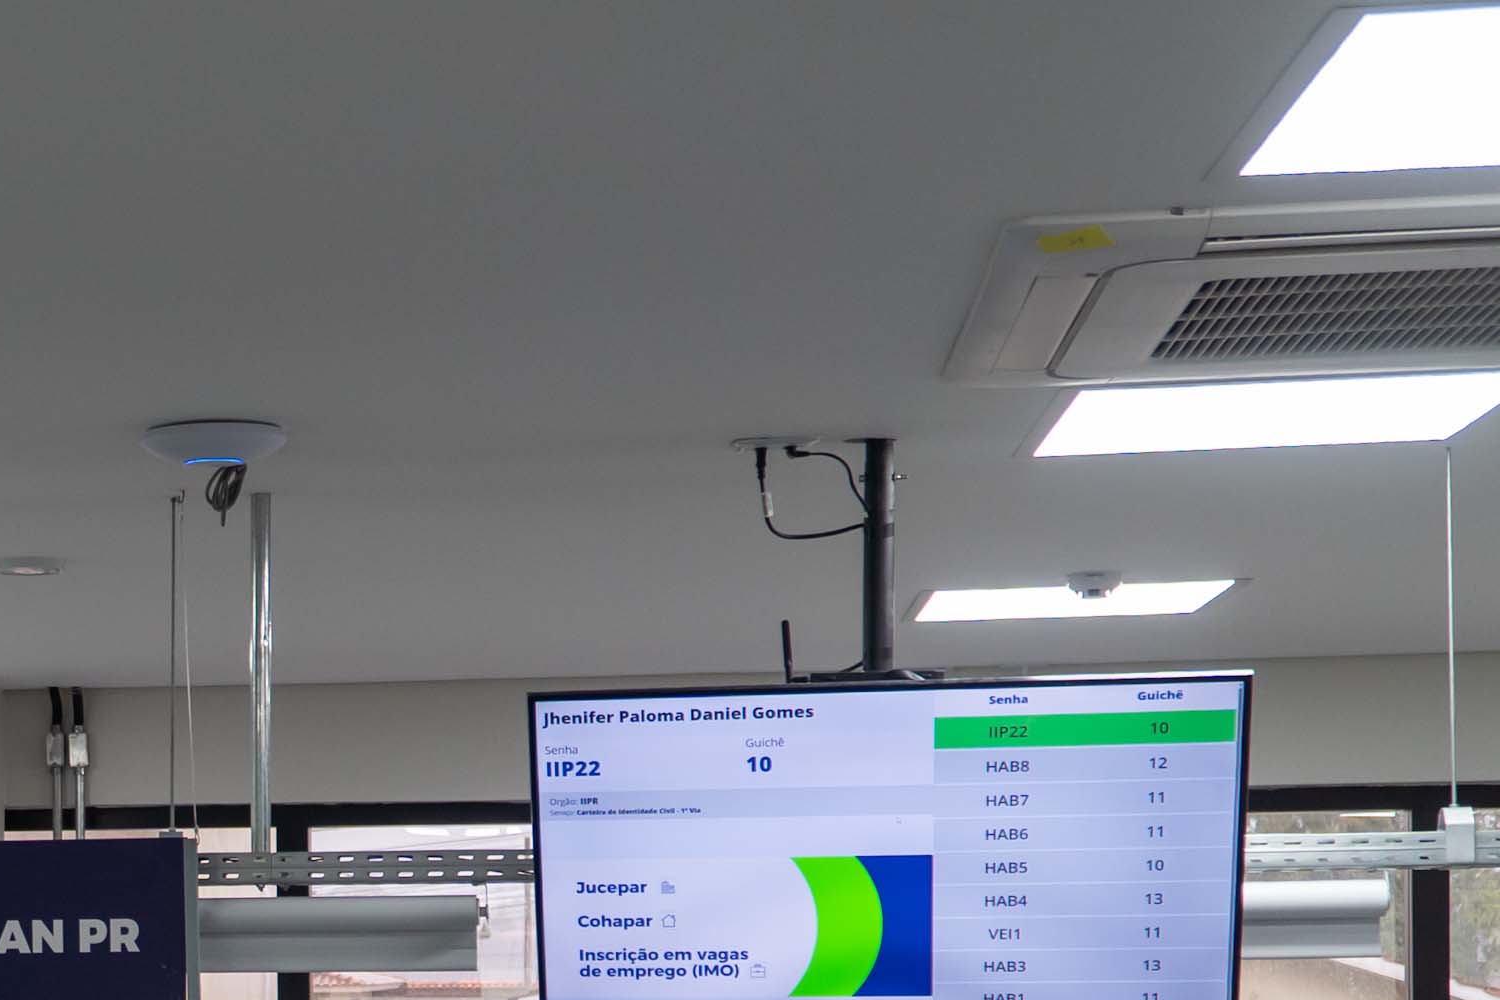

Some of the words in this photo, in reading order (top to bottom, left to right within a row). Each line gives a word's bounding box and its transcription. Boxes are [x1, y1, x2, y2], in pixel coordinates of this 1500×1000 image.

[988, 694, 1028, 704] Senha
[1137, 690, 1184, 700] Guichê
[542, 711, 614, 729] Jhenifer
[620, 709, 685, 722] Paloma
[690, 706, 746, 720] Daniel
[752, 706, 814, 719] Gomes
[989, 726, 1028, 738] IIP22
[1150, 722, 1170, 735] 10
[544, 745, 578, 754] Senha
[746, 738, 785, 748] Guichê
[546, 761, 600, 776] IIP22
[746, 756, 772, 772] 10
[986, 760, 1030, 773] HAB8
[1150, 757, 1168, 769] 12
[986, 794, 1030, 807] HAB7
[1148, 792, 1165, 804] 11
[576, 808, 606, 816] Carteira
[608, 808, 617, 816] de
[986, 828, 1028, 840] HAB6
[1148, 826, 1164, 838] 11
[985, 862, 1028, 874] HAB5
[1146, 860, 1164, 872] 10
[576, 882, 648, 896] Jucepar
[984, 895, 1028, 908] HAB4
[1145, 893, 1163, 905] 13
[578, 915, 652, 930] Cohapar
[79, 918, 140, 953] PR
[1144, 927, 1160, 939] 11
[579, 948, 658, 964] Inscrição
[663, 952, 692, 960] em
[697, 950, 749, 963] vagas
[580, 965, 602, 977] de
[606, 966, 686, 980] emprego
[692, 964, 740, 979] (IMO)
[984, 961, 1026, 973] HAB3
[1143, 960, 1161, 972] 13
